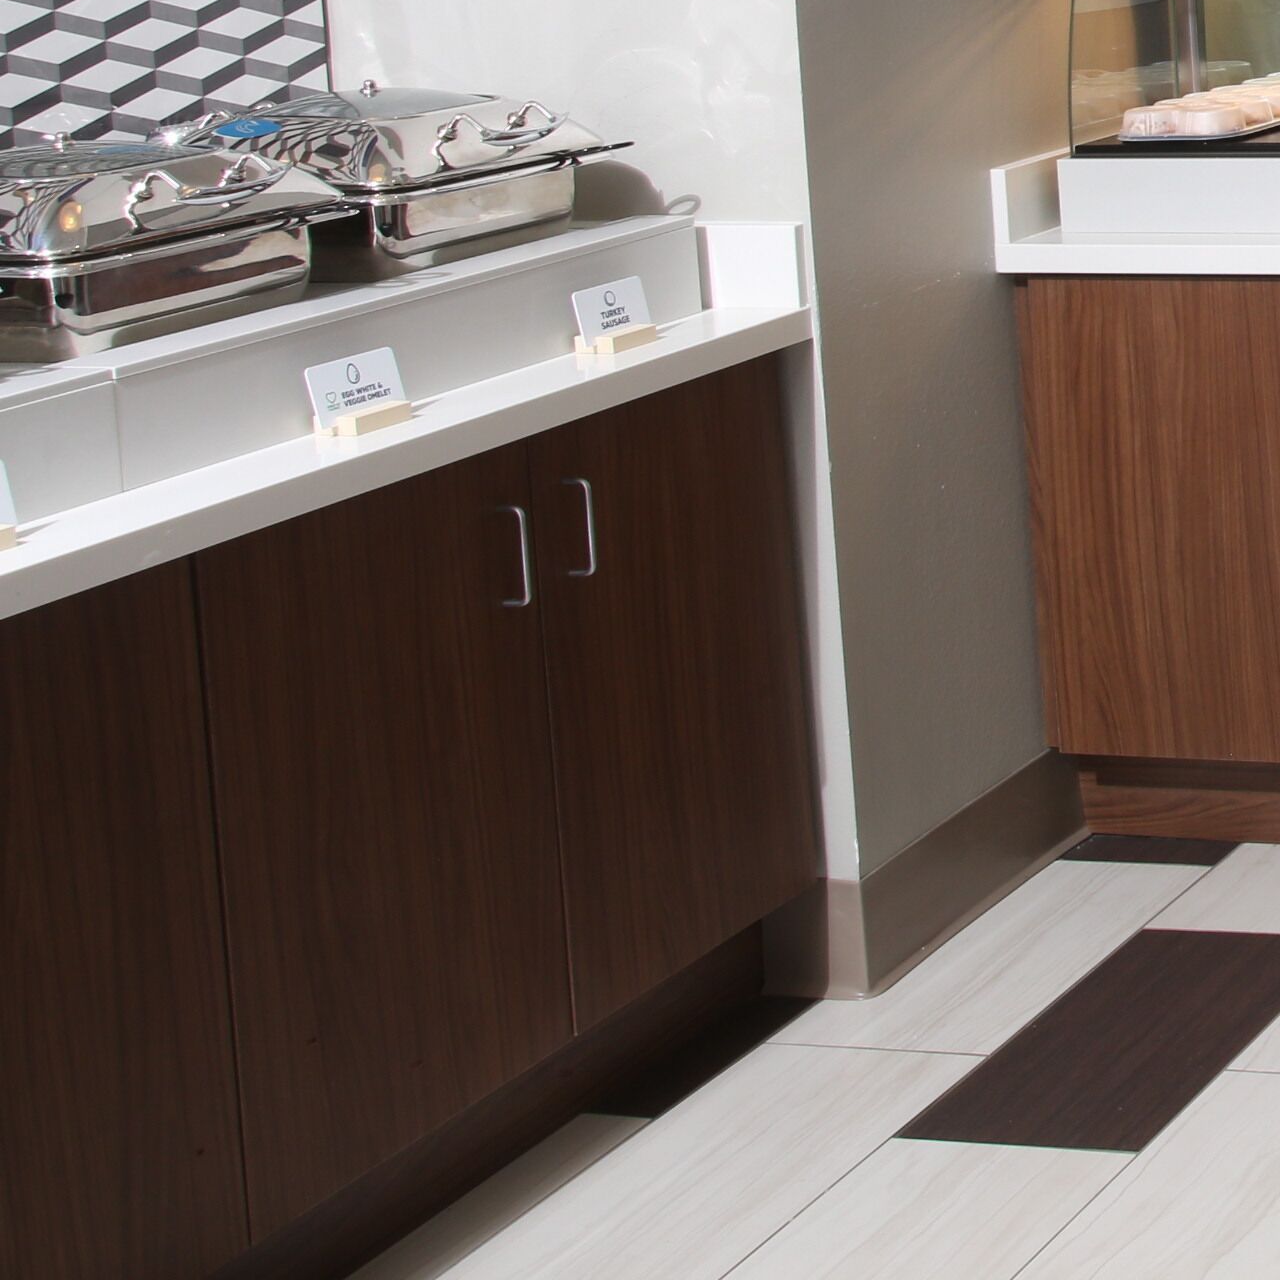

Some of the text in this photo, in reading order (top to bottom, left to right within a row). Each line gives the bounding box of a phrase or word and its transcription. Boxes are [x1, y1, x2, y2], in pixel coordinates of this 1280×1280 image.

[600, 305, 626, 320] TURKEY
[600, 314, 631, 330] SAUSAGE
[341, 389, 356, 399] EGG
[355, 382, 377, 394] WHITE
[344, 387, 392, 407] VEGGIE OMELET
